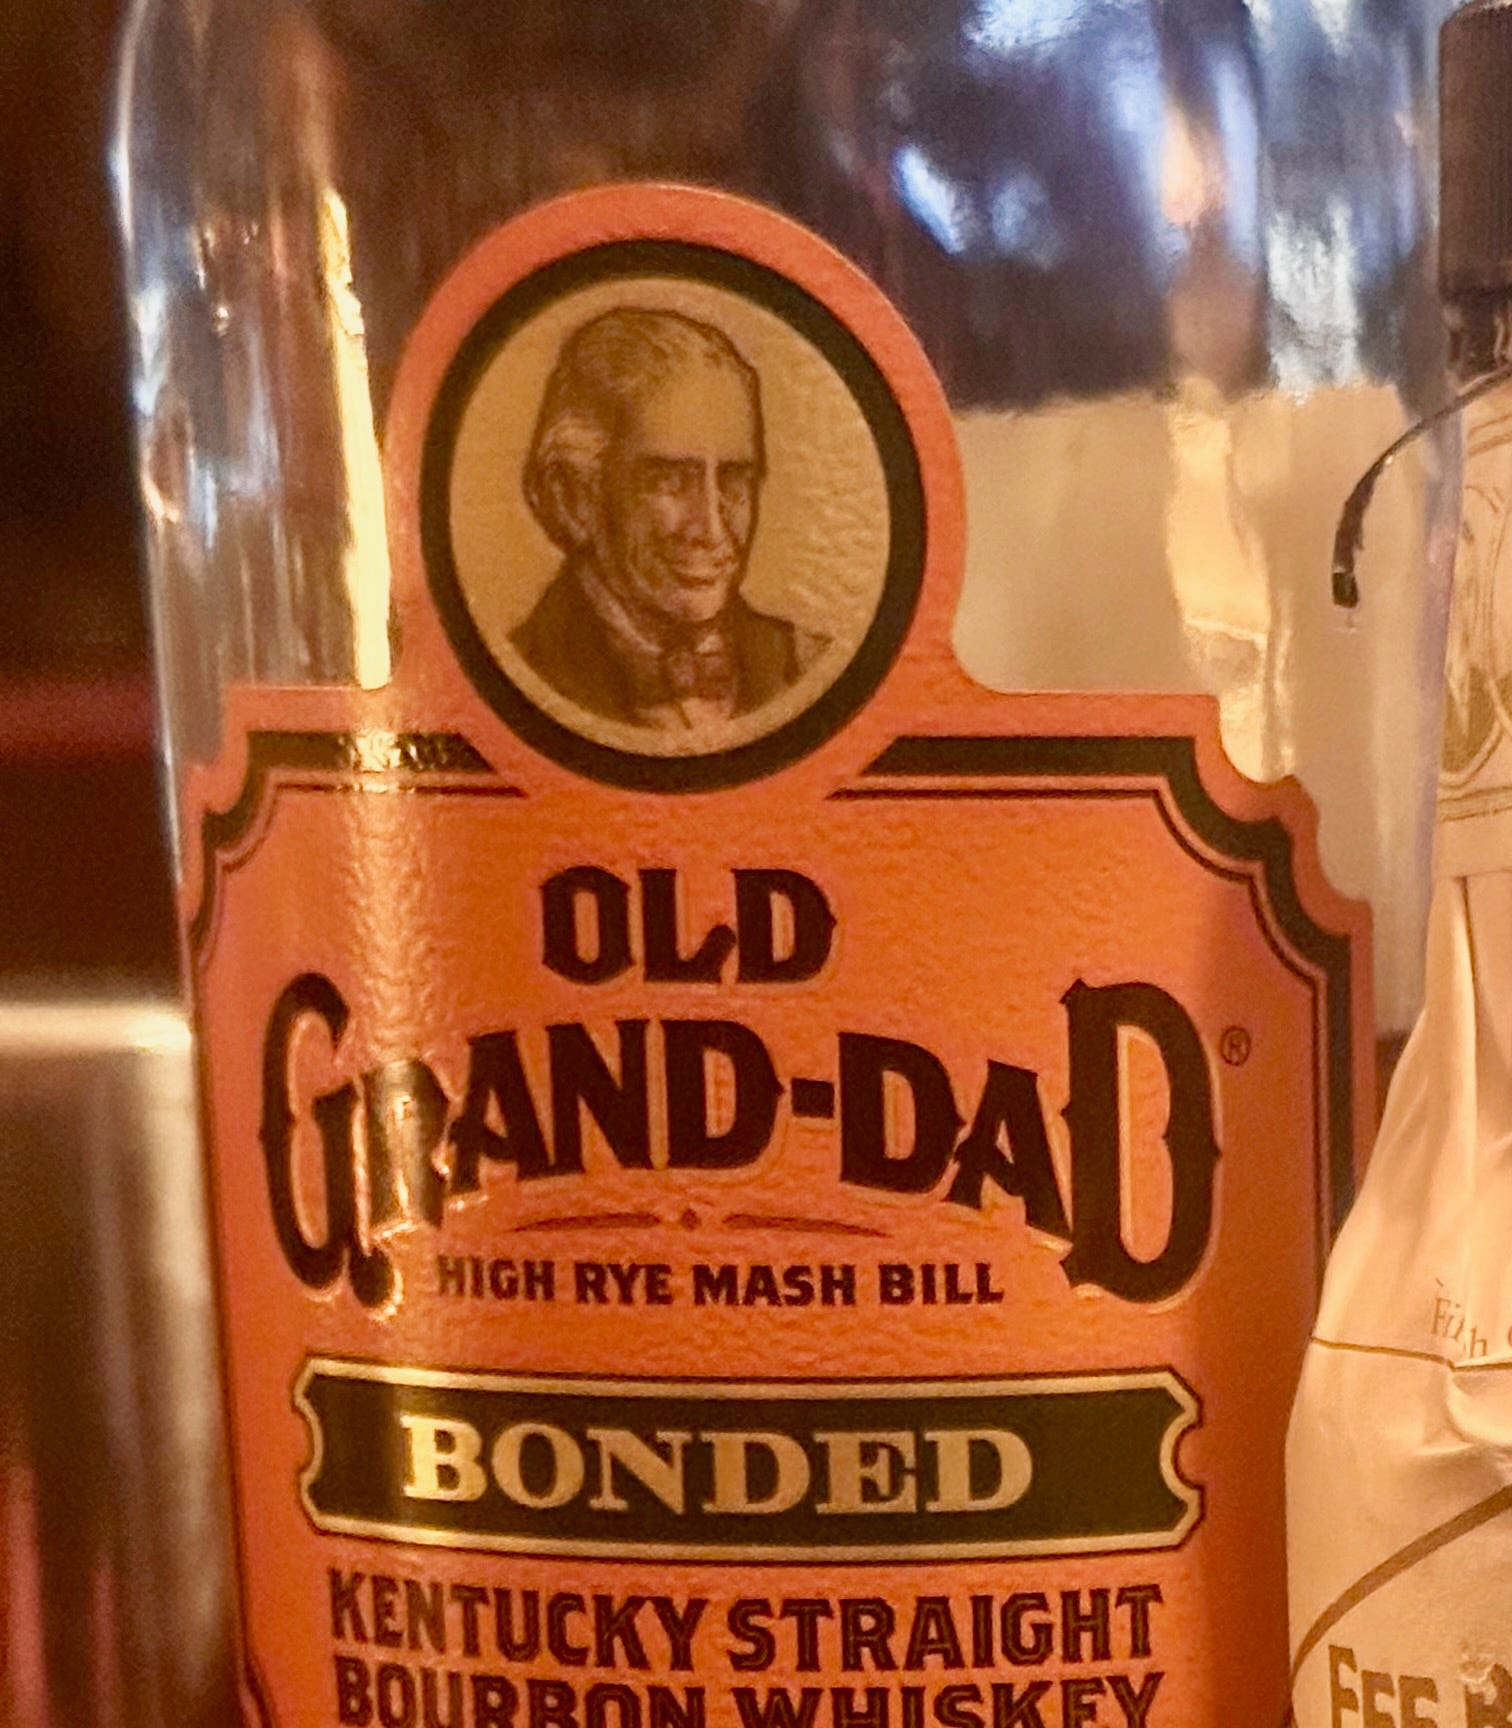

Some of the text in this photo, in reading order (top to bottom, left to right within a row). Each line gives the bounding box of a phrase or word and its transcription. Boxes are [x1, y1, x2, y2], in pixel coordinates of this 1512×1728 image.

[539, 864, 838, 985] OLD
[261, 971, 1222, 1306] GRAND-DAD
[437, 1256, 1004, 1306] HIGH RYE MASH BILL
[400, 1414, 1034, 1517] BONDED
[327, 1566, 1163, 1673] KENTUCKY STRAIGHT
